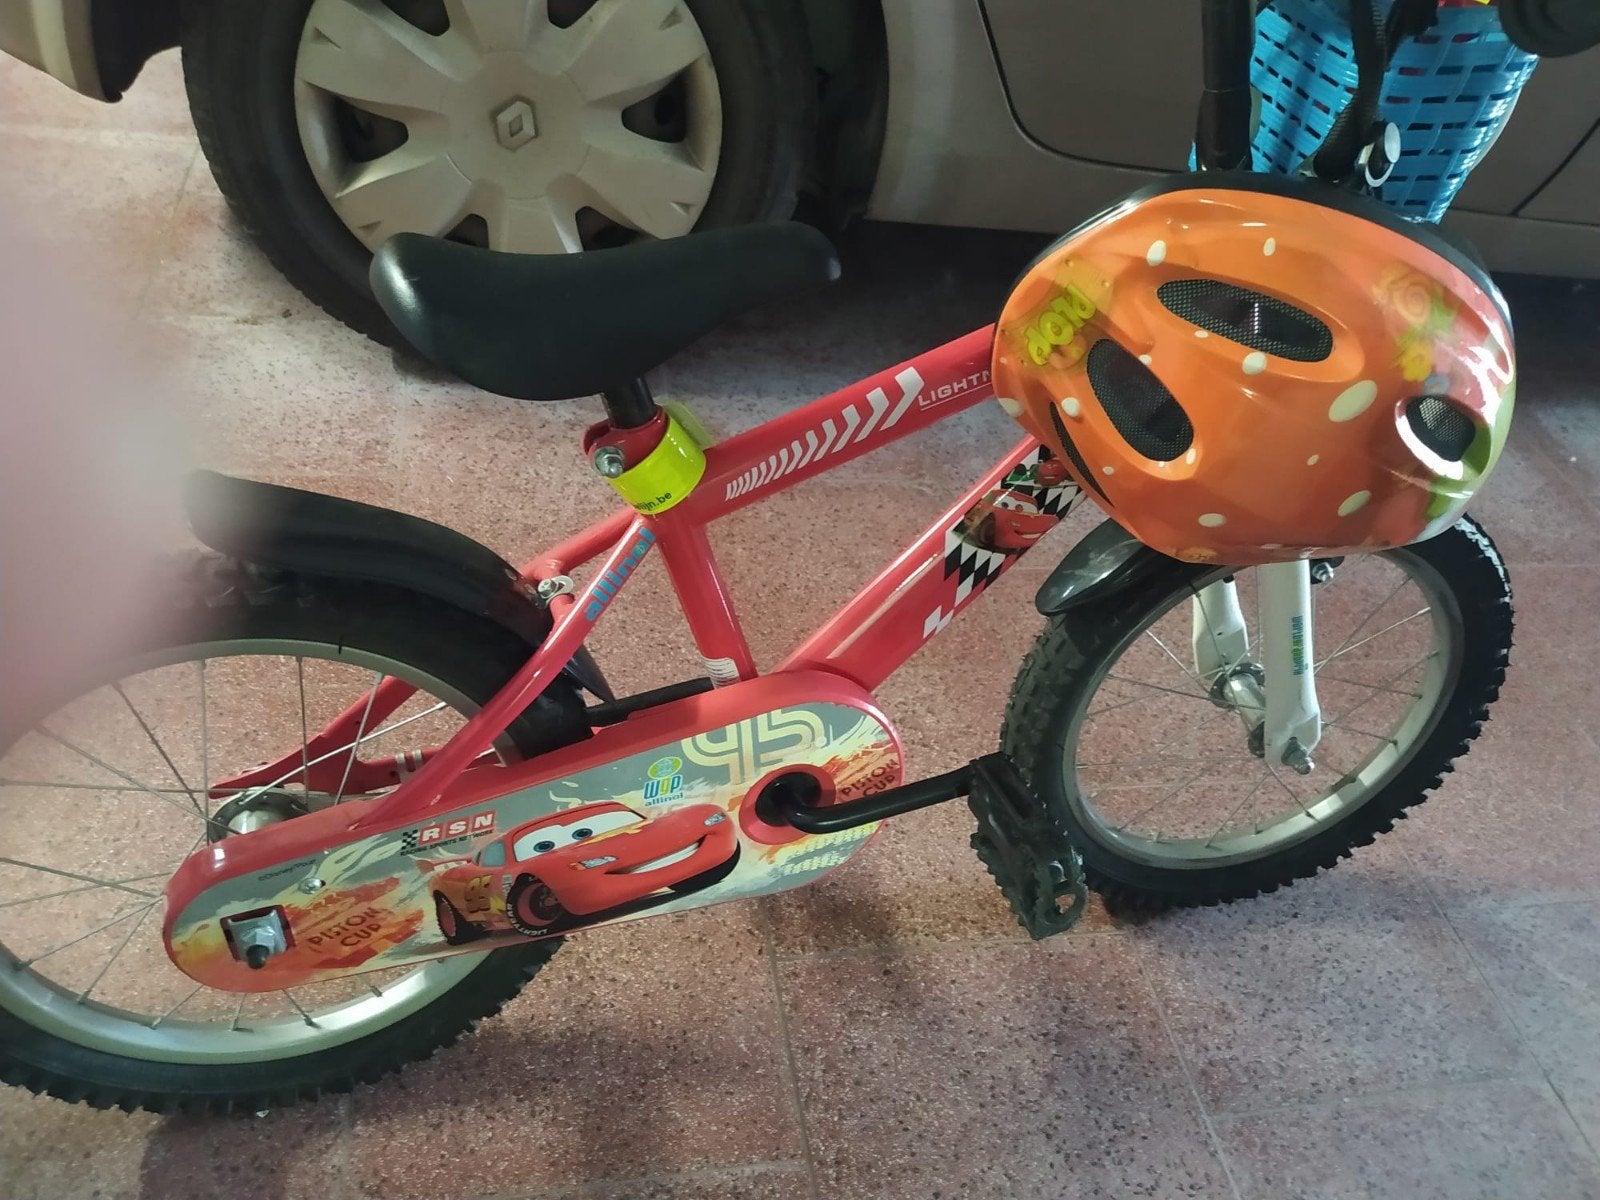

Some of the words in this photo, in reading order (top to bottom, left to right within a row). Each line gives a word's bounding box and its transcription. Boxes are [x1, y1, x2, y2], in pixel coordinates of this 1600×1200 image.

[1025, 283, 1097, 366] PLOP
[841, 759, 899, 797] PISTON
[863, 774, 896, 798] CUP
[308, 906, 380, 946] PISTON
[340, 922, 381, 947] CUP
